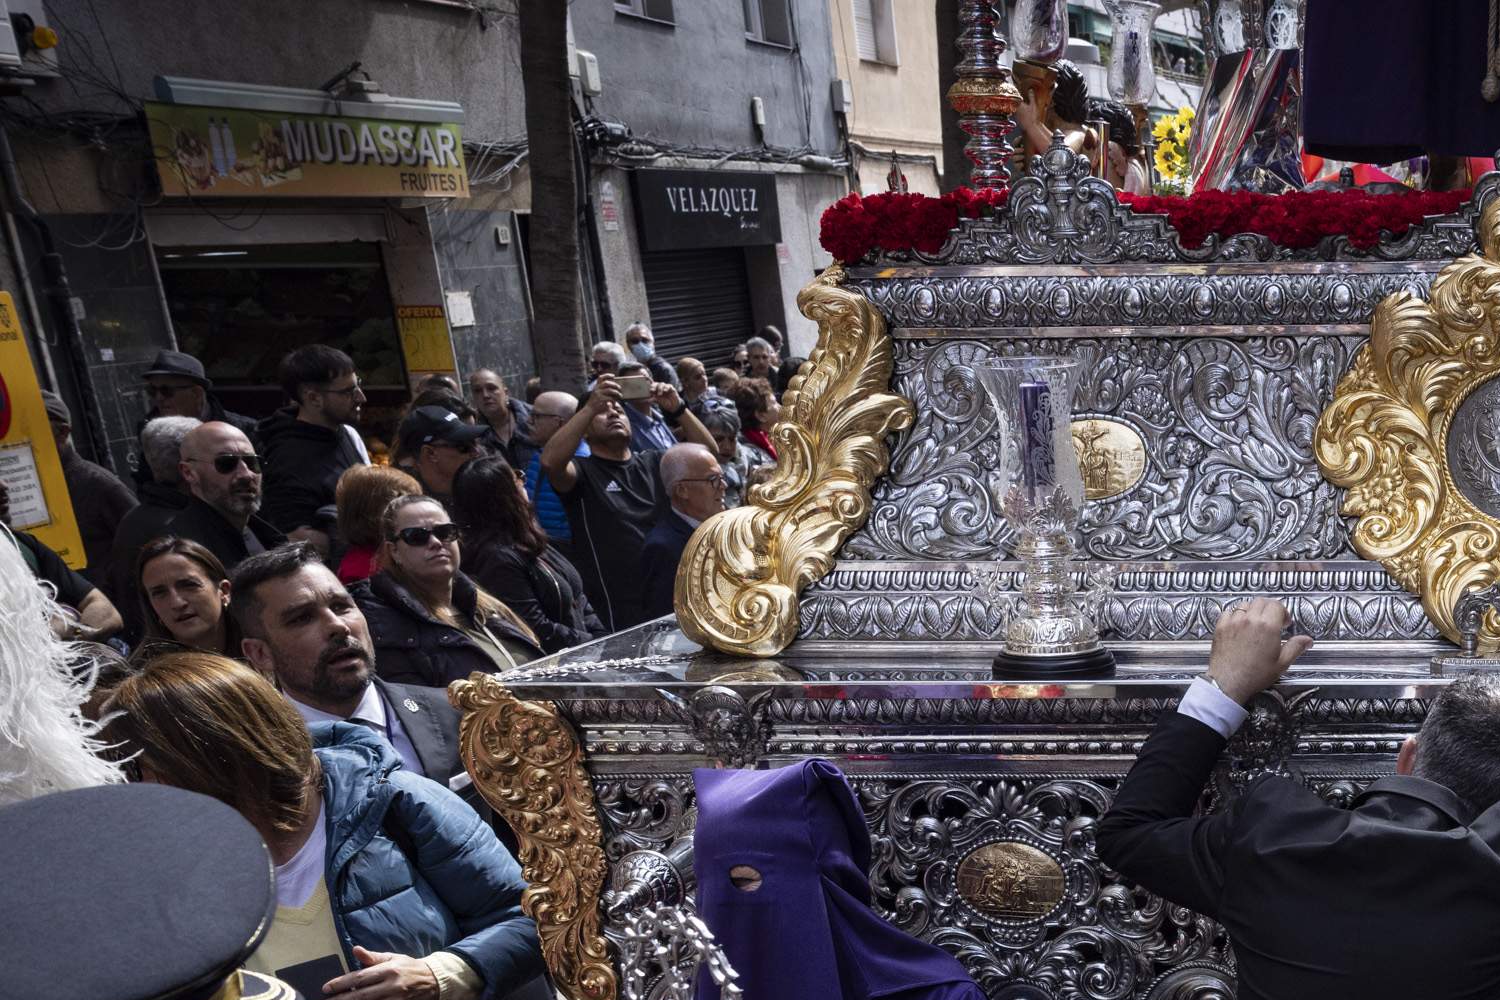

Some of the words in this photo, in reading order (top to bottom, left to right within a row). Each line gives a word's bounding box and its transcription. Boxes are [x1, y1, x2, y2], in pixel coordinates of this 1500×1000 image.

[280, 119, 460, 168] MUDASSAR
[400, 172, 457, 192] FRUITES
[459, 175, 465, 192] I
[666, 186, 759, 217] VELAZQUEZ
[398, 306, 443, 317] OFERTA
